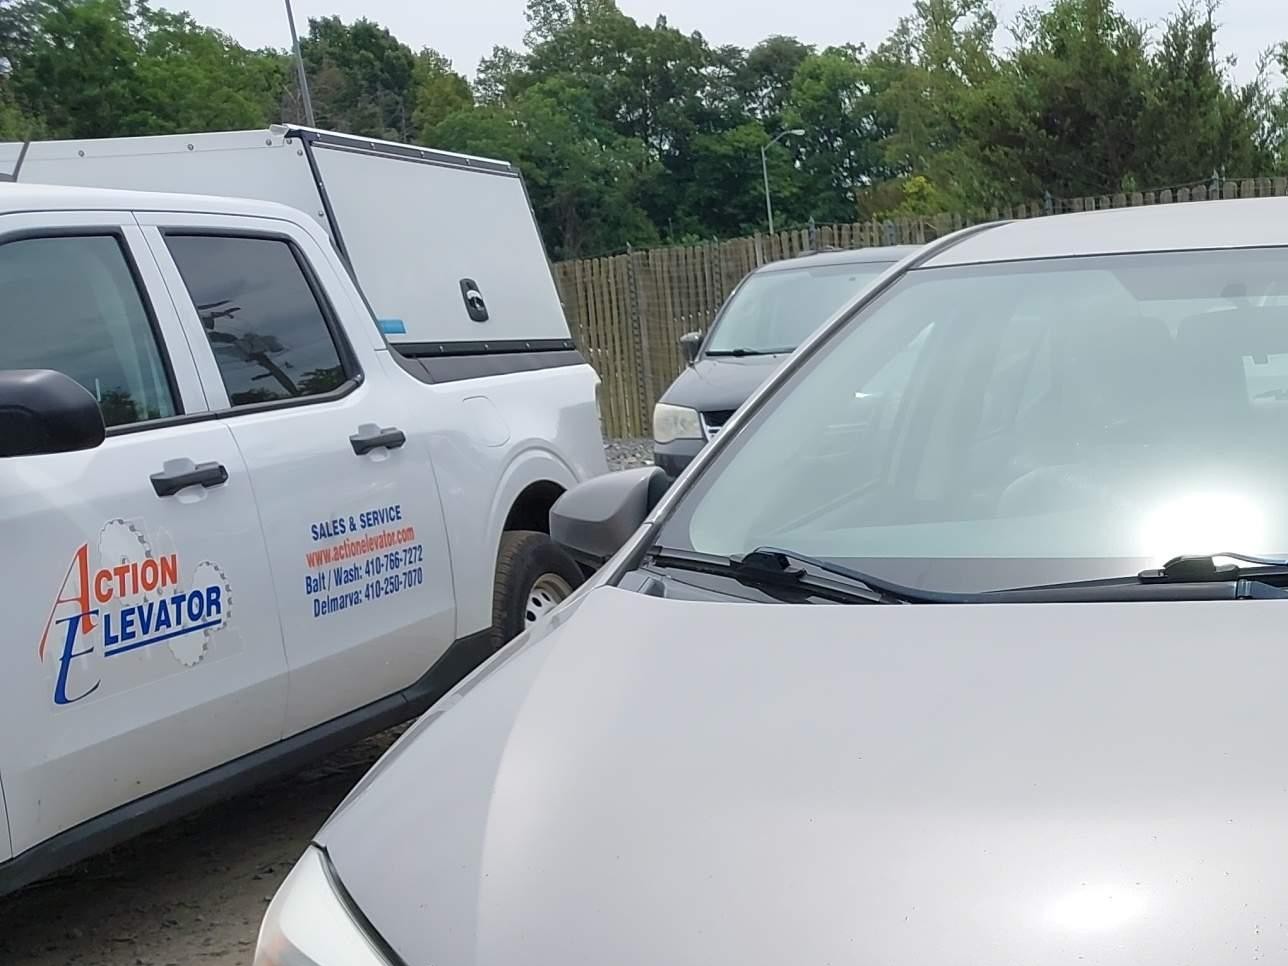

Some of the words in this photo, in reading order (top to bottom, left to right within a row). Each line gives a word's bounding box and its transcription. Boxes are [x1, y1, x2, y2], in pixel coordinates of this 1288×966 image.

[306, 526, 415, 568] www.actionelevator.com
[311, 518, 347, 541] SALES
[349, 516, 357, 532] &
[359, 504, 402, 530] SERVICE
[305, 571, 326, 594] Balt
[328, 569, 332, 592] /
[333, 563, 363, 587] Wash:
[364, 544, 423, 578] 410-766-7272
[313, 588, 363, 617] Delmarva:
[364, 567, 423, 600] 410-250-7070
[38, 543, 178, 664] ACTION
[54, 585, 222, 705] ELEVATOR
